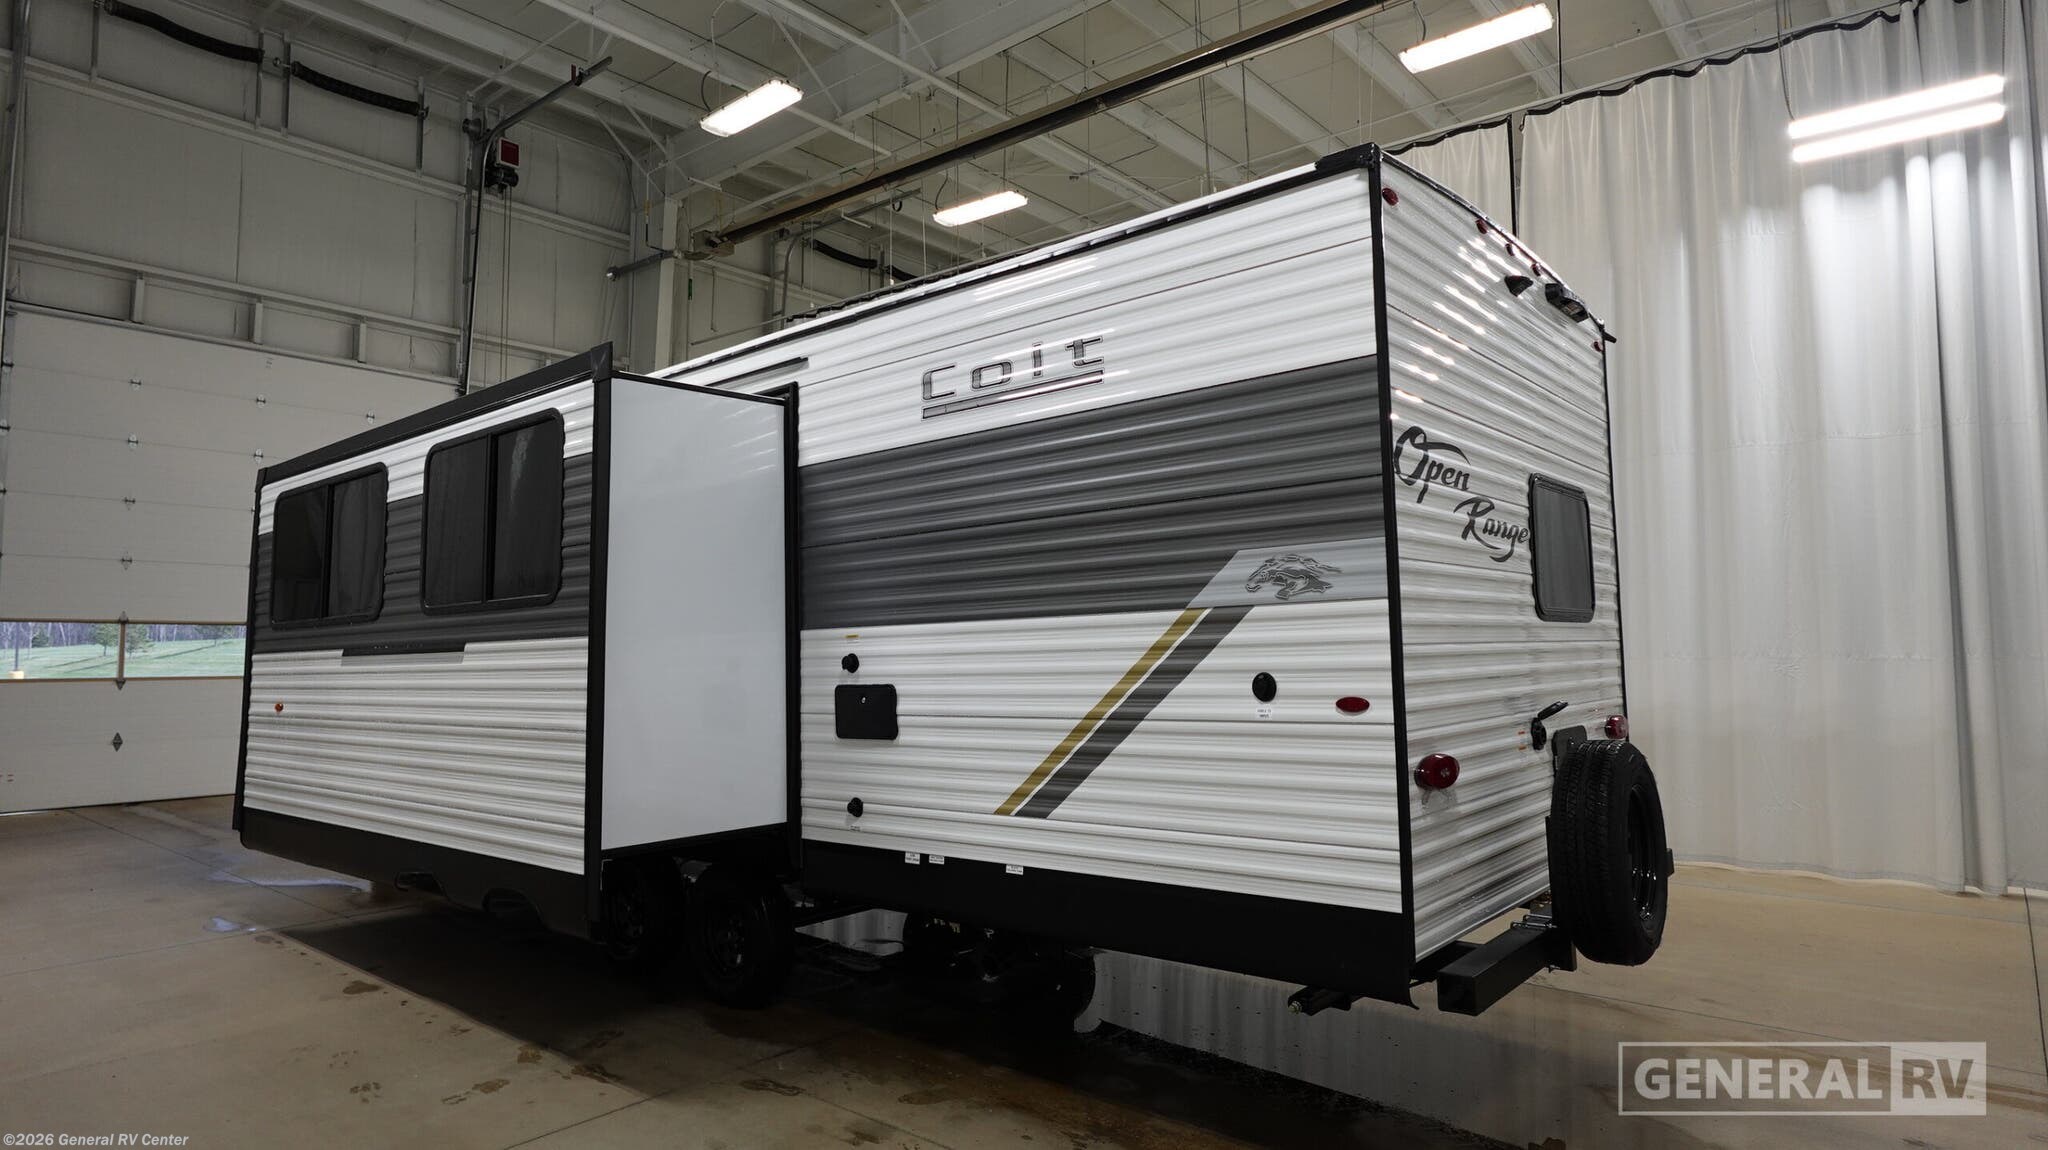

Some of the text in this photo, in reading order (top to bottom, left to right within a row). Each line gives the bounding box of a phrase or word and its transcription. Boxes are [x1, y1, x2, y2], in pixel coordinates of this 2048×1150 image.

[922, 336, 1104, 402] Colt
[1394, 426, 1471, 504] Open
[1453, 496, 1529, 562] Range
